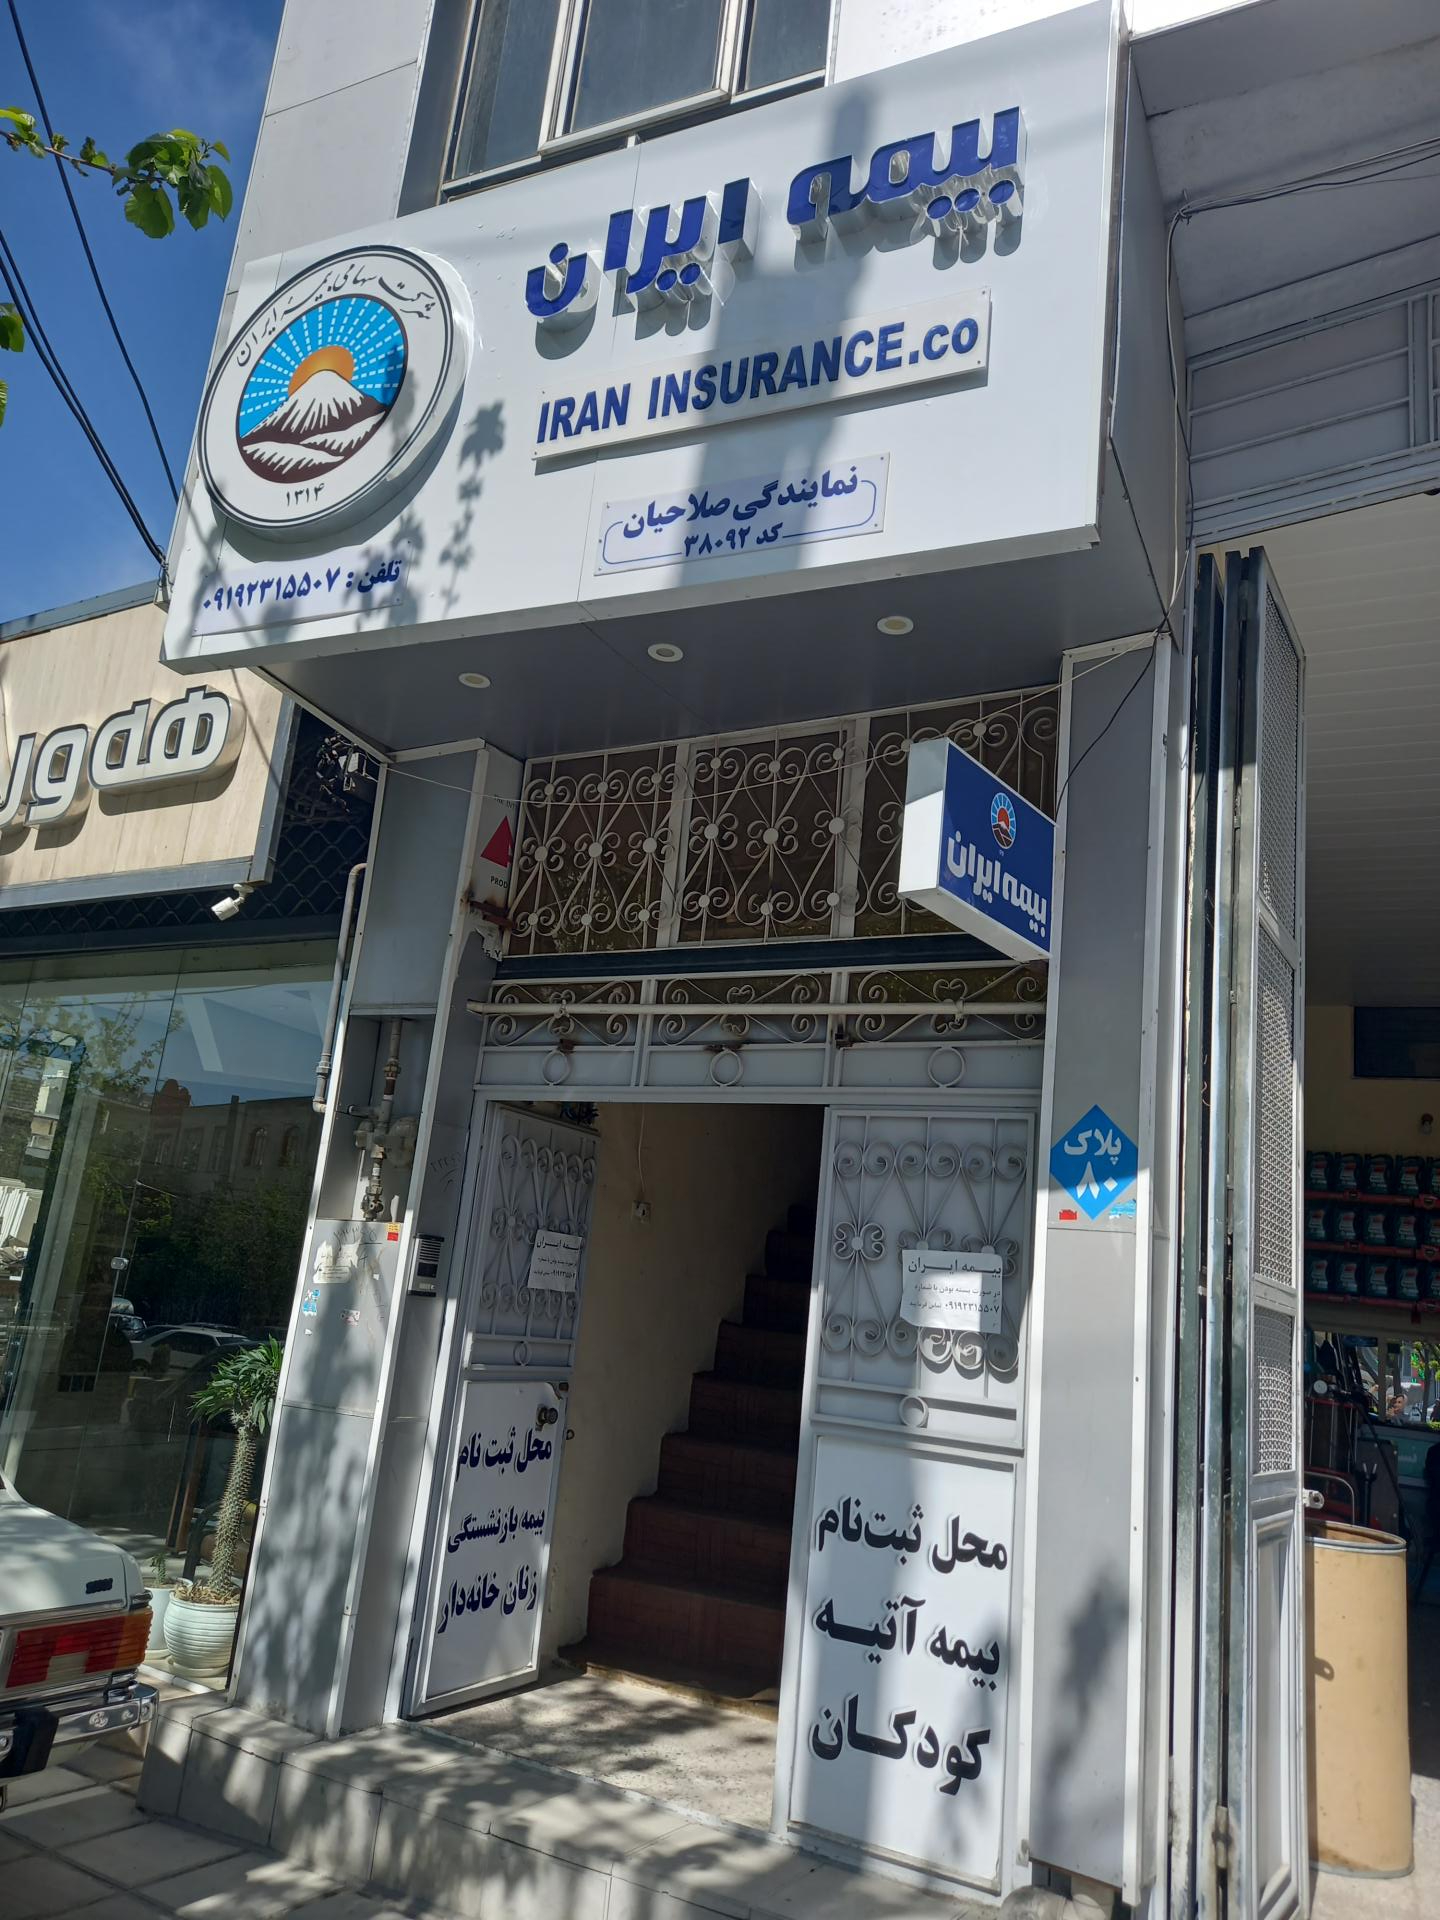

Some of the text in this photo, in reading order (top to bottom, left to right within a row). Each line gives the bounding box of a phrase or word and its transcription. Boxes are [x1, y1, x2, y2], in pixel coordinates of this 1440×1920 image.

[526, 107, 1020, 316] بیمه ایران
[537, 383, 631, 443] IRAN
[286, 483, 326, 506] ۱۳۱۴
[623, 465, 858, 538] نمایندگی صلاحیان
[683, 522, 783, 557] کد ۳۸۰۹۲
[203, 567, 341, 611] ۰۹۱۹۲۳۱۵۵۰۷
[947, 831, 1047, 937] بیمه ایران
[1064, 1128, 1122, 1165] پلاک
[1076, 1161, 1118, 1199] ۸۰
[908, 1257, 1001, 1278] بیمه ایران
[516, 1429, 552, 1472] محل
[447, 1506, 545, 1553] بیمه بازنشستگی
[932, 1516, 1008, 1574] محل
[502, 1565, 538, 1615] زنان
[815, 1596, 1000, 1690] بیمه آتیه
[811, 1694, 991, 1795] کودکان
